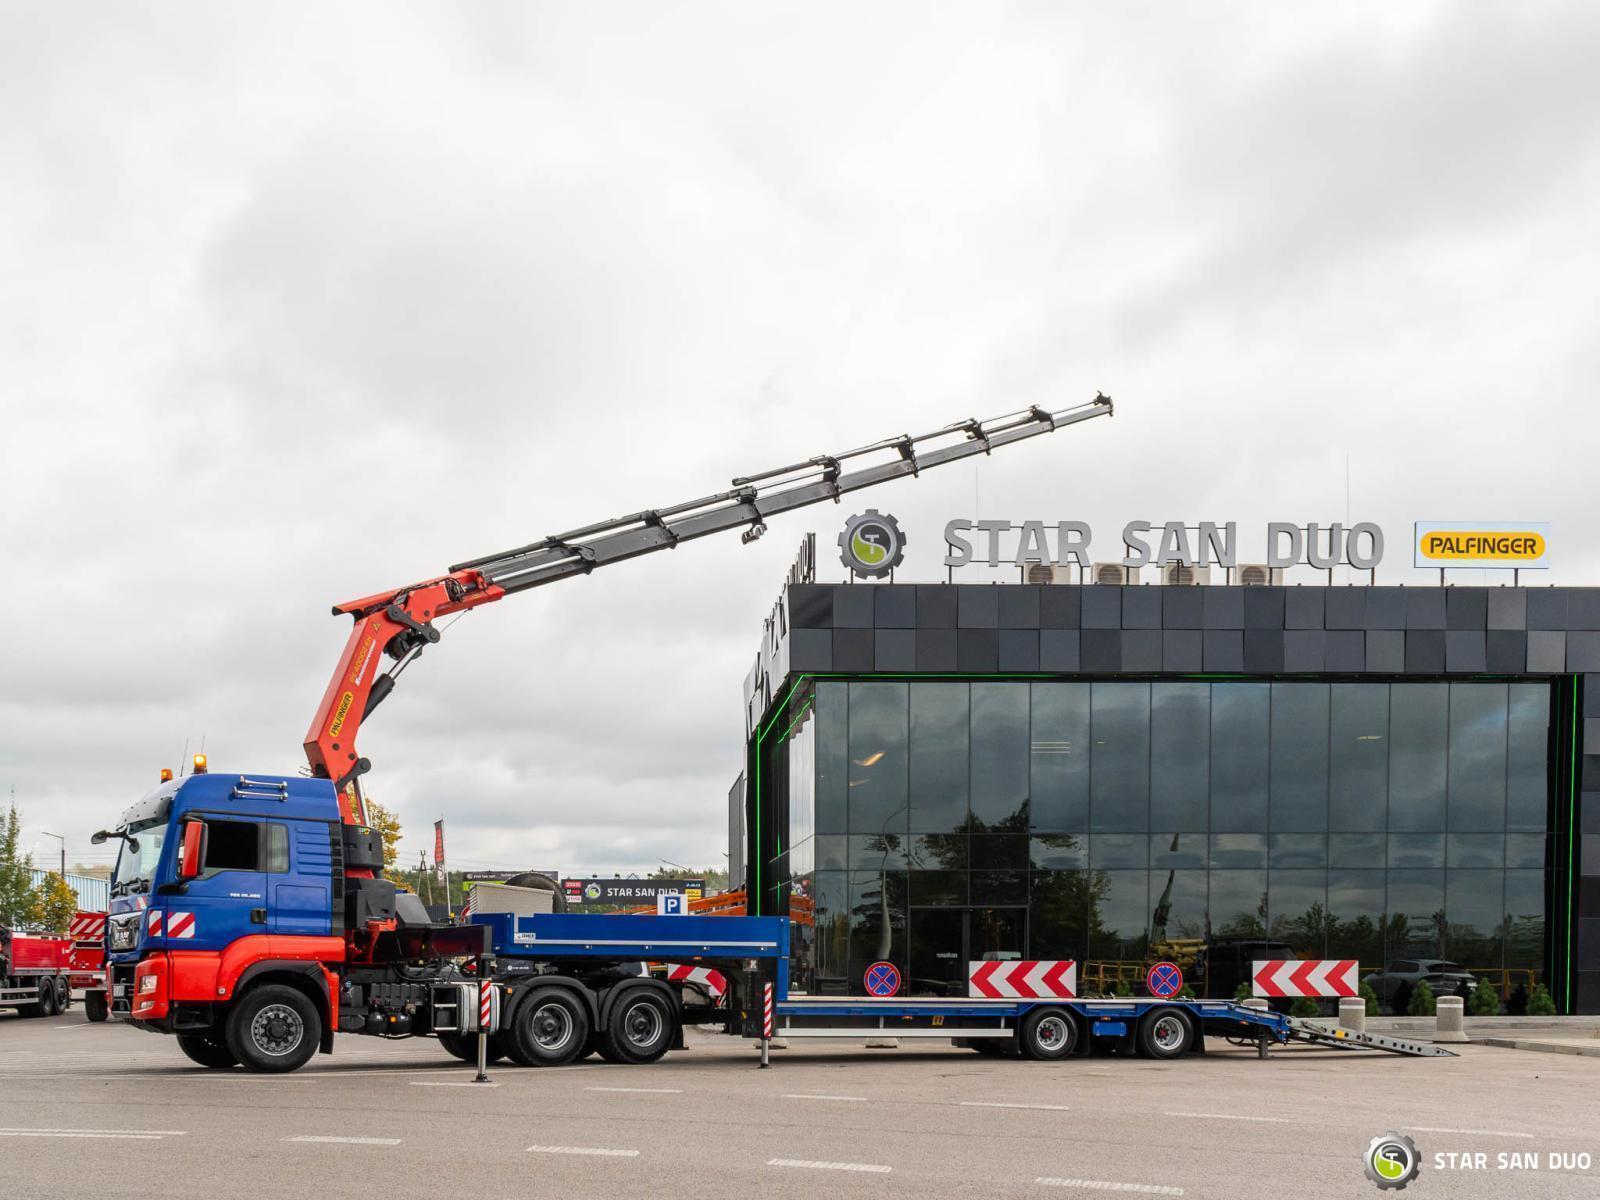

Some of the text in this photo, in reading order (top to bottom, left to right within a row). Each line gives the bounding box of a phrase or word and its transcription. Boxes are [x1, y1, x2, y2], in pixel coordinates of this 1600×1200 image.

[944, 519, 1384, 569] STAR SAN DUO
[1430, 536, 1537, 555] PALFINGER
[331, 694, 352, 735] PALFINGER
[607, 887, 632, 897] STAR
[633, 887, 656, 897] SAN
[667, 898, 678, 913] P
